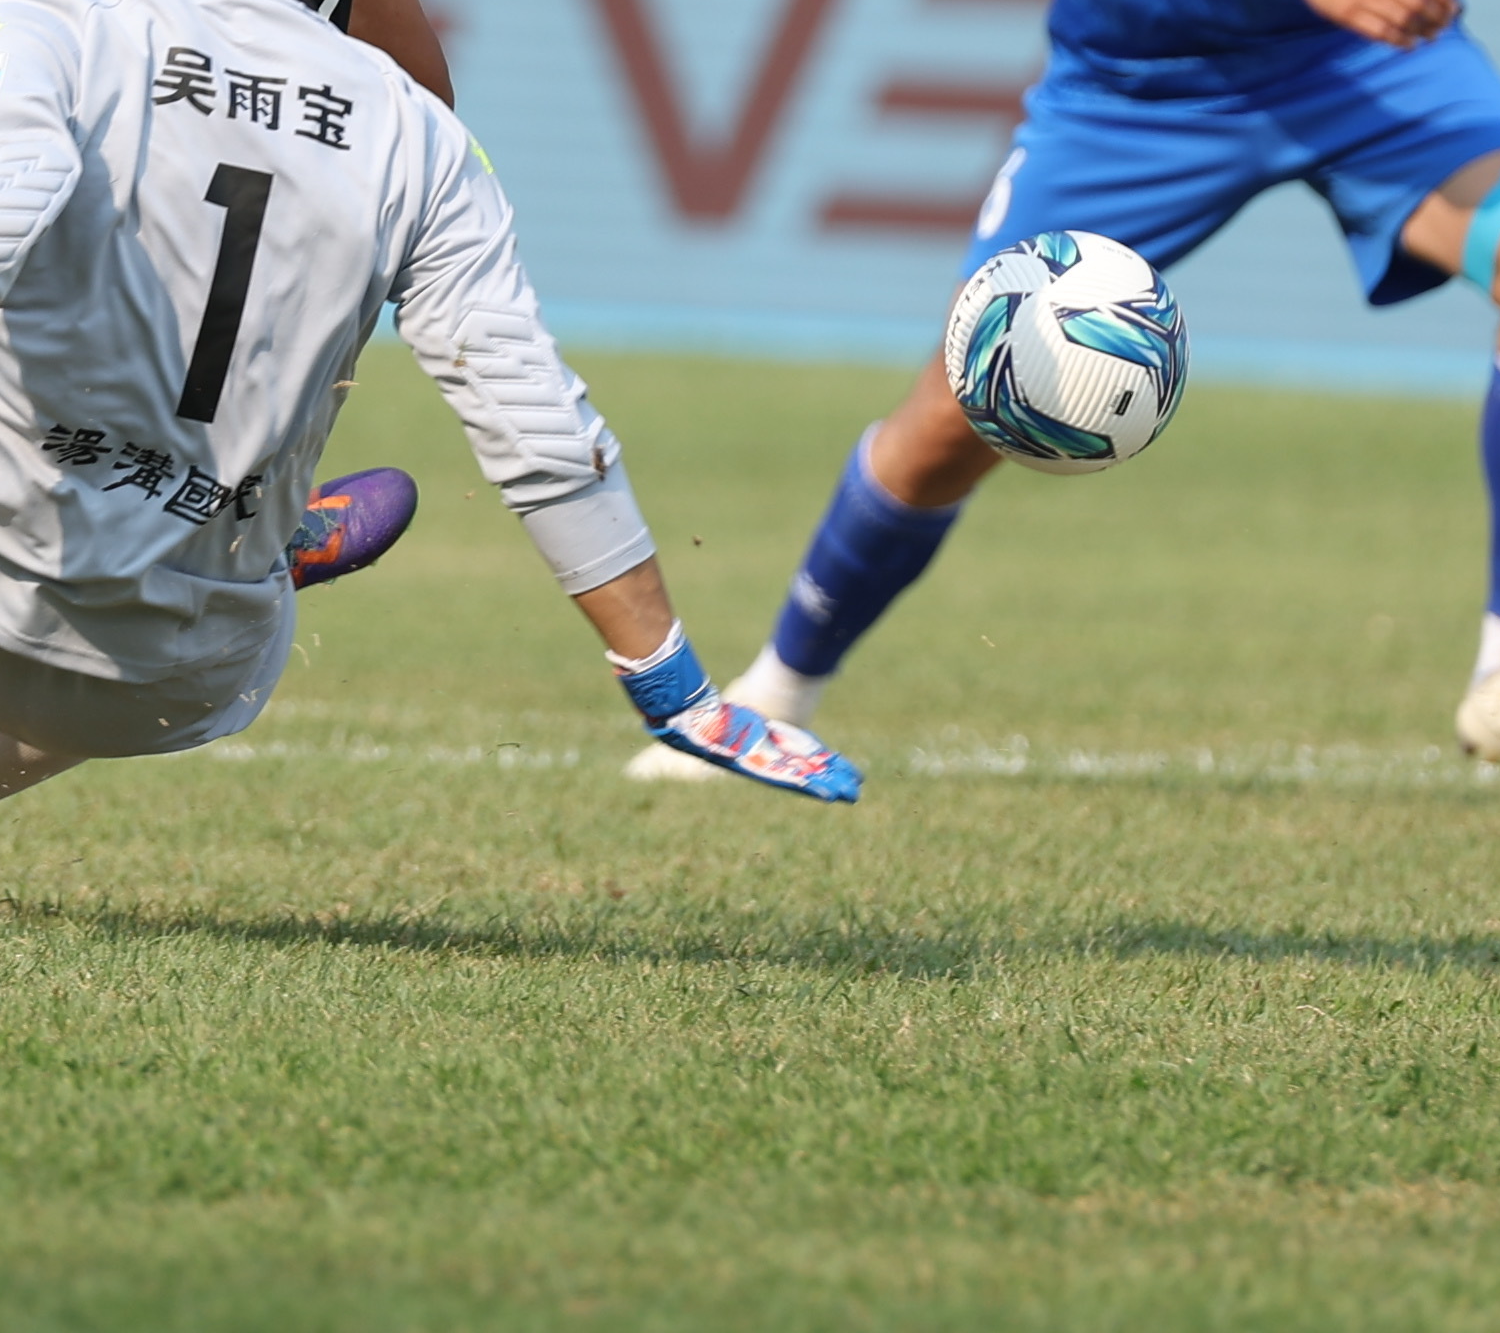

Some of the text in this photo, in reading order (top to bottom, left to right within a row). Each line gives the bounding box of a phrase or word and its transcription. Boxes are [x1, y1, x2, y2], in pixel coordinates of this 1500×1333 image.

[153, 46, 353, 151] 吴雨宝
[175, 163, 273, 424] 1
